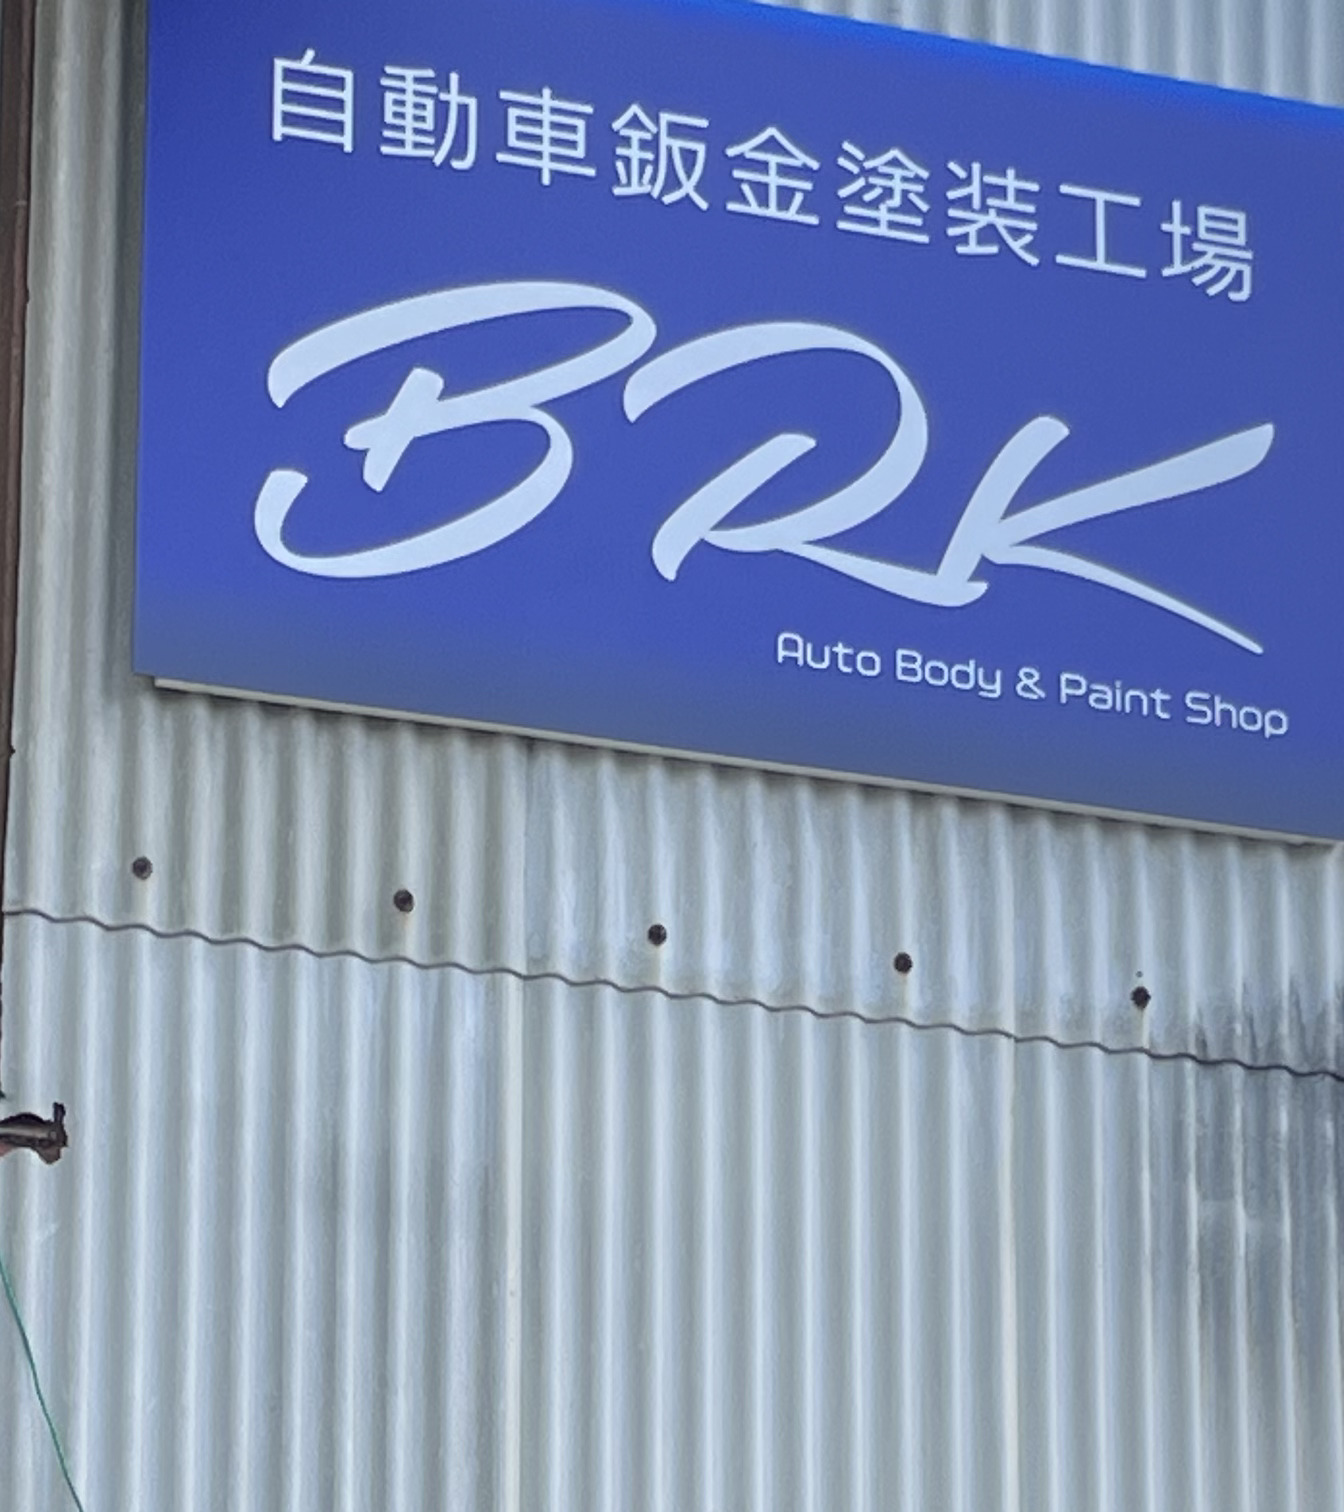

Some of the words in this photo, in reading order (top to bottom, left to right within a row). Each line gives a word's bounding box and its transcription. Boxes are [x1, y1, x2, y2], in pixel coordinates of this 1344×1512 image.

[270, 47, 1254, 302] 自動車鈑金塗装工場
[254, 279, 1275, 655] BRK
[776, 631, 882, 678] Auto
[895, 647, 1003, 699] Body
[1014, 666, 1047, 701] &
[1059, 671, 1172, 720] Paint
[1184, 690, 1289, 739] Shop
